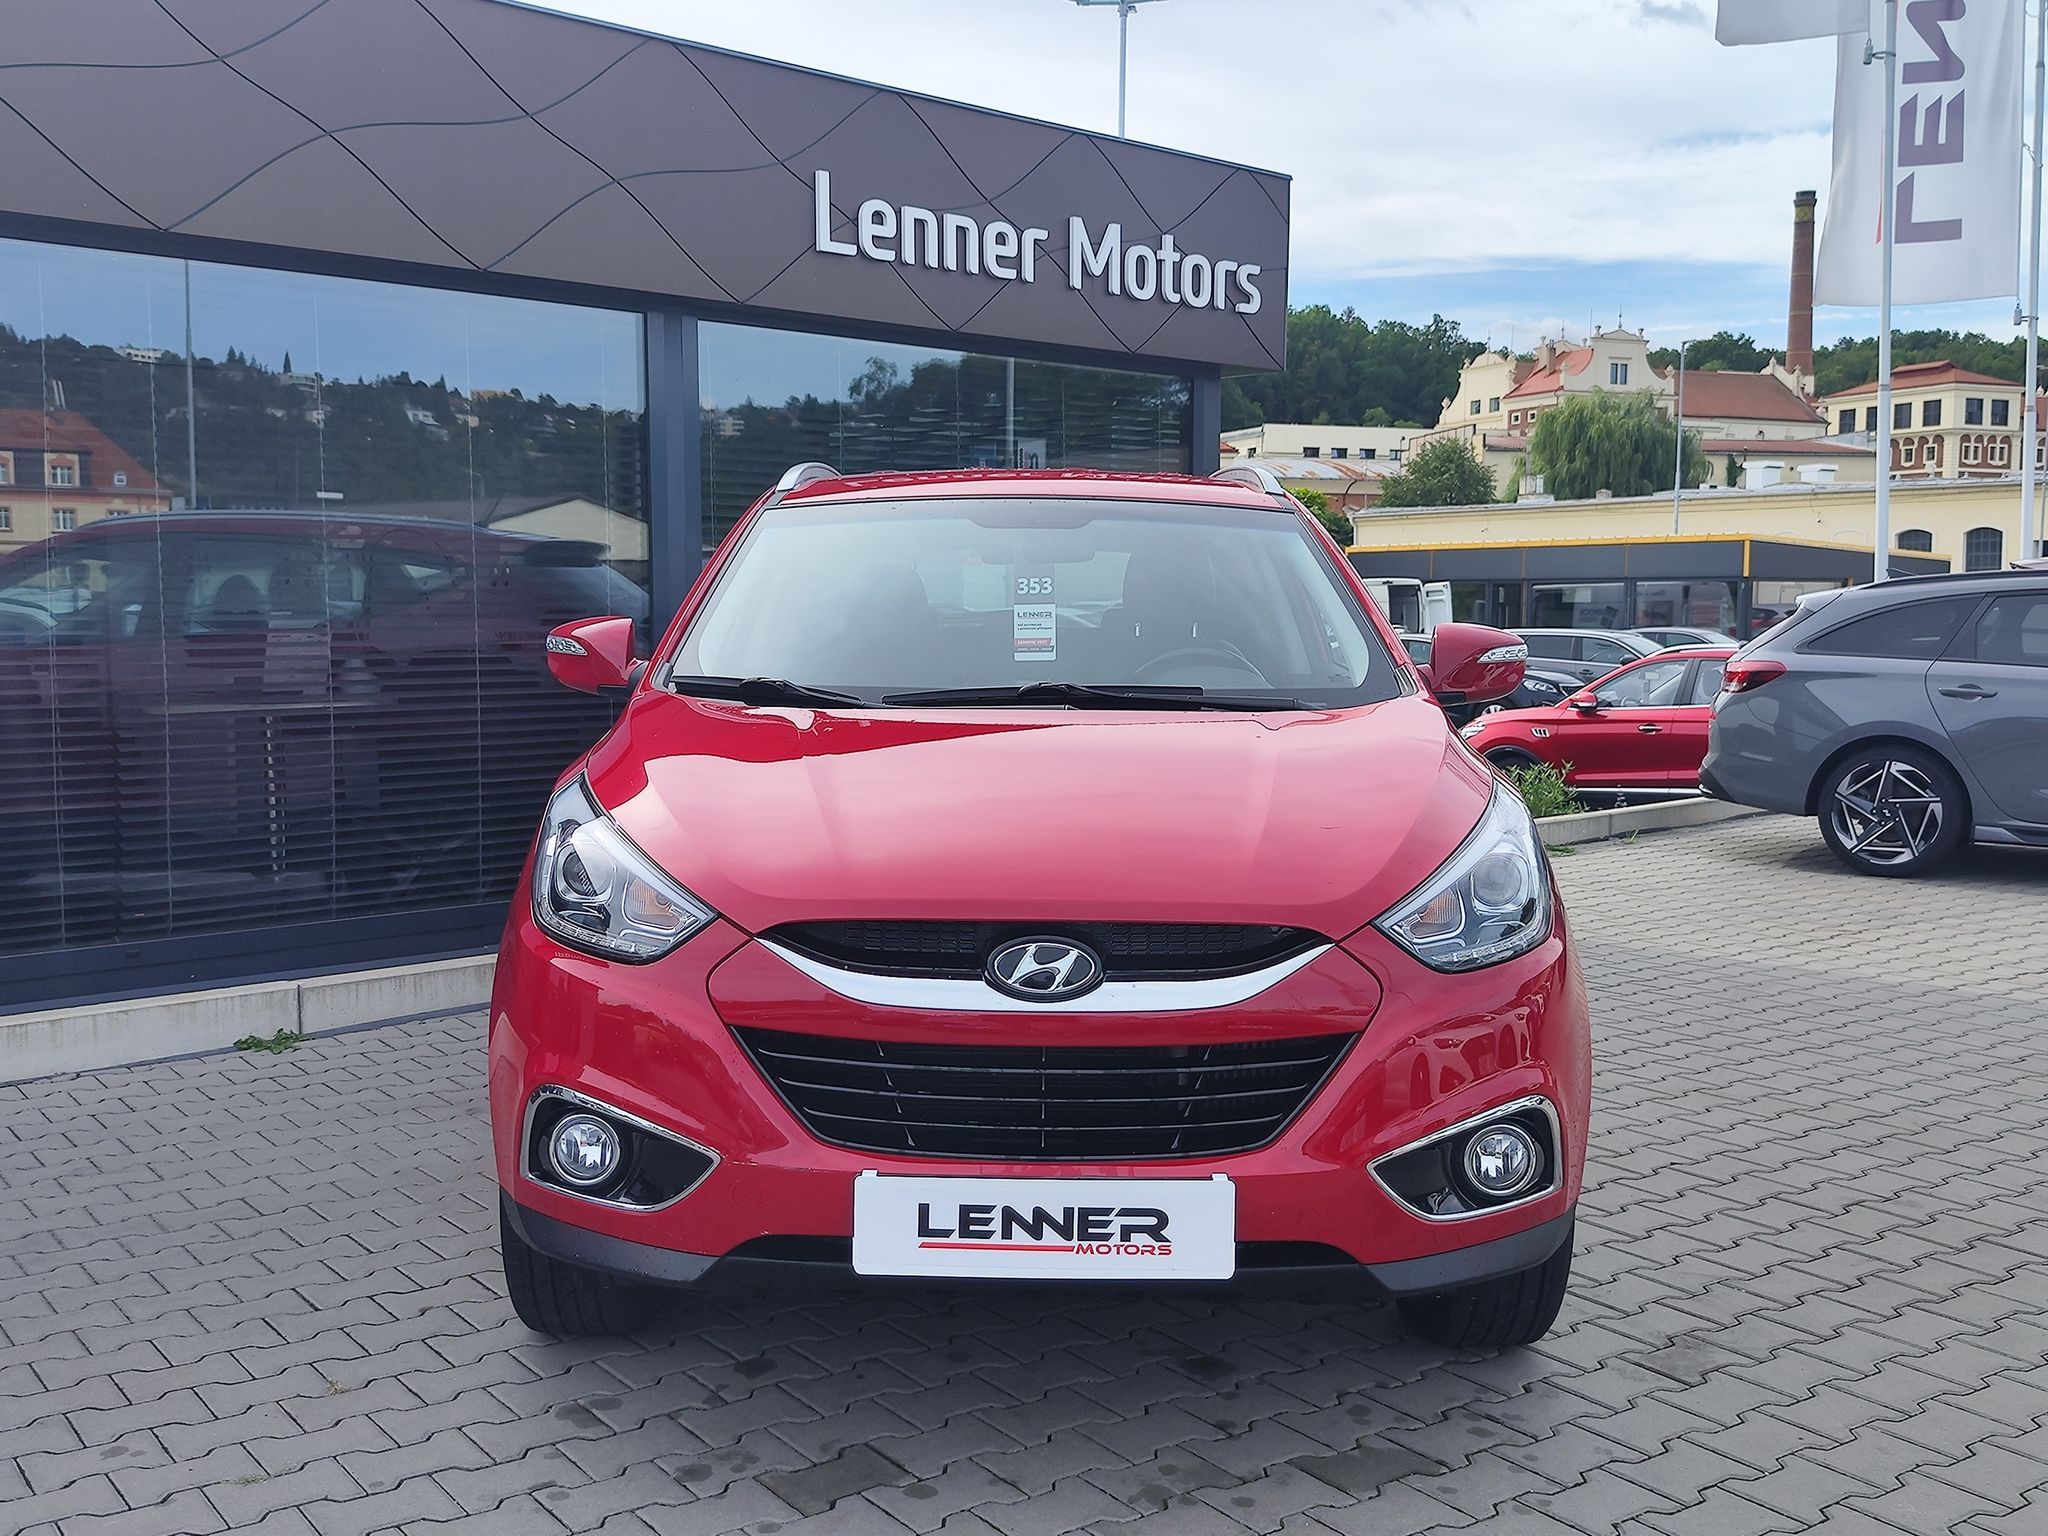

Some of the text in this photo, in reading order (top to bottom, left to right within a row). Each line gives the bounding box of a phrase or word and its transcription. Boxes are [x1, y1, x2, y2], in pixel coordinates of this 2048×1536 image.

[814, 169, 1262, 315] Lenner Motors
[1016, 577, 1053, 595] 353
[1017, 611, 1053, 619] LENNER
[917, 1202, 1173, 1244] LENNER
[1075, 1242, 1173, 1257] MOTORS
